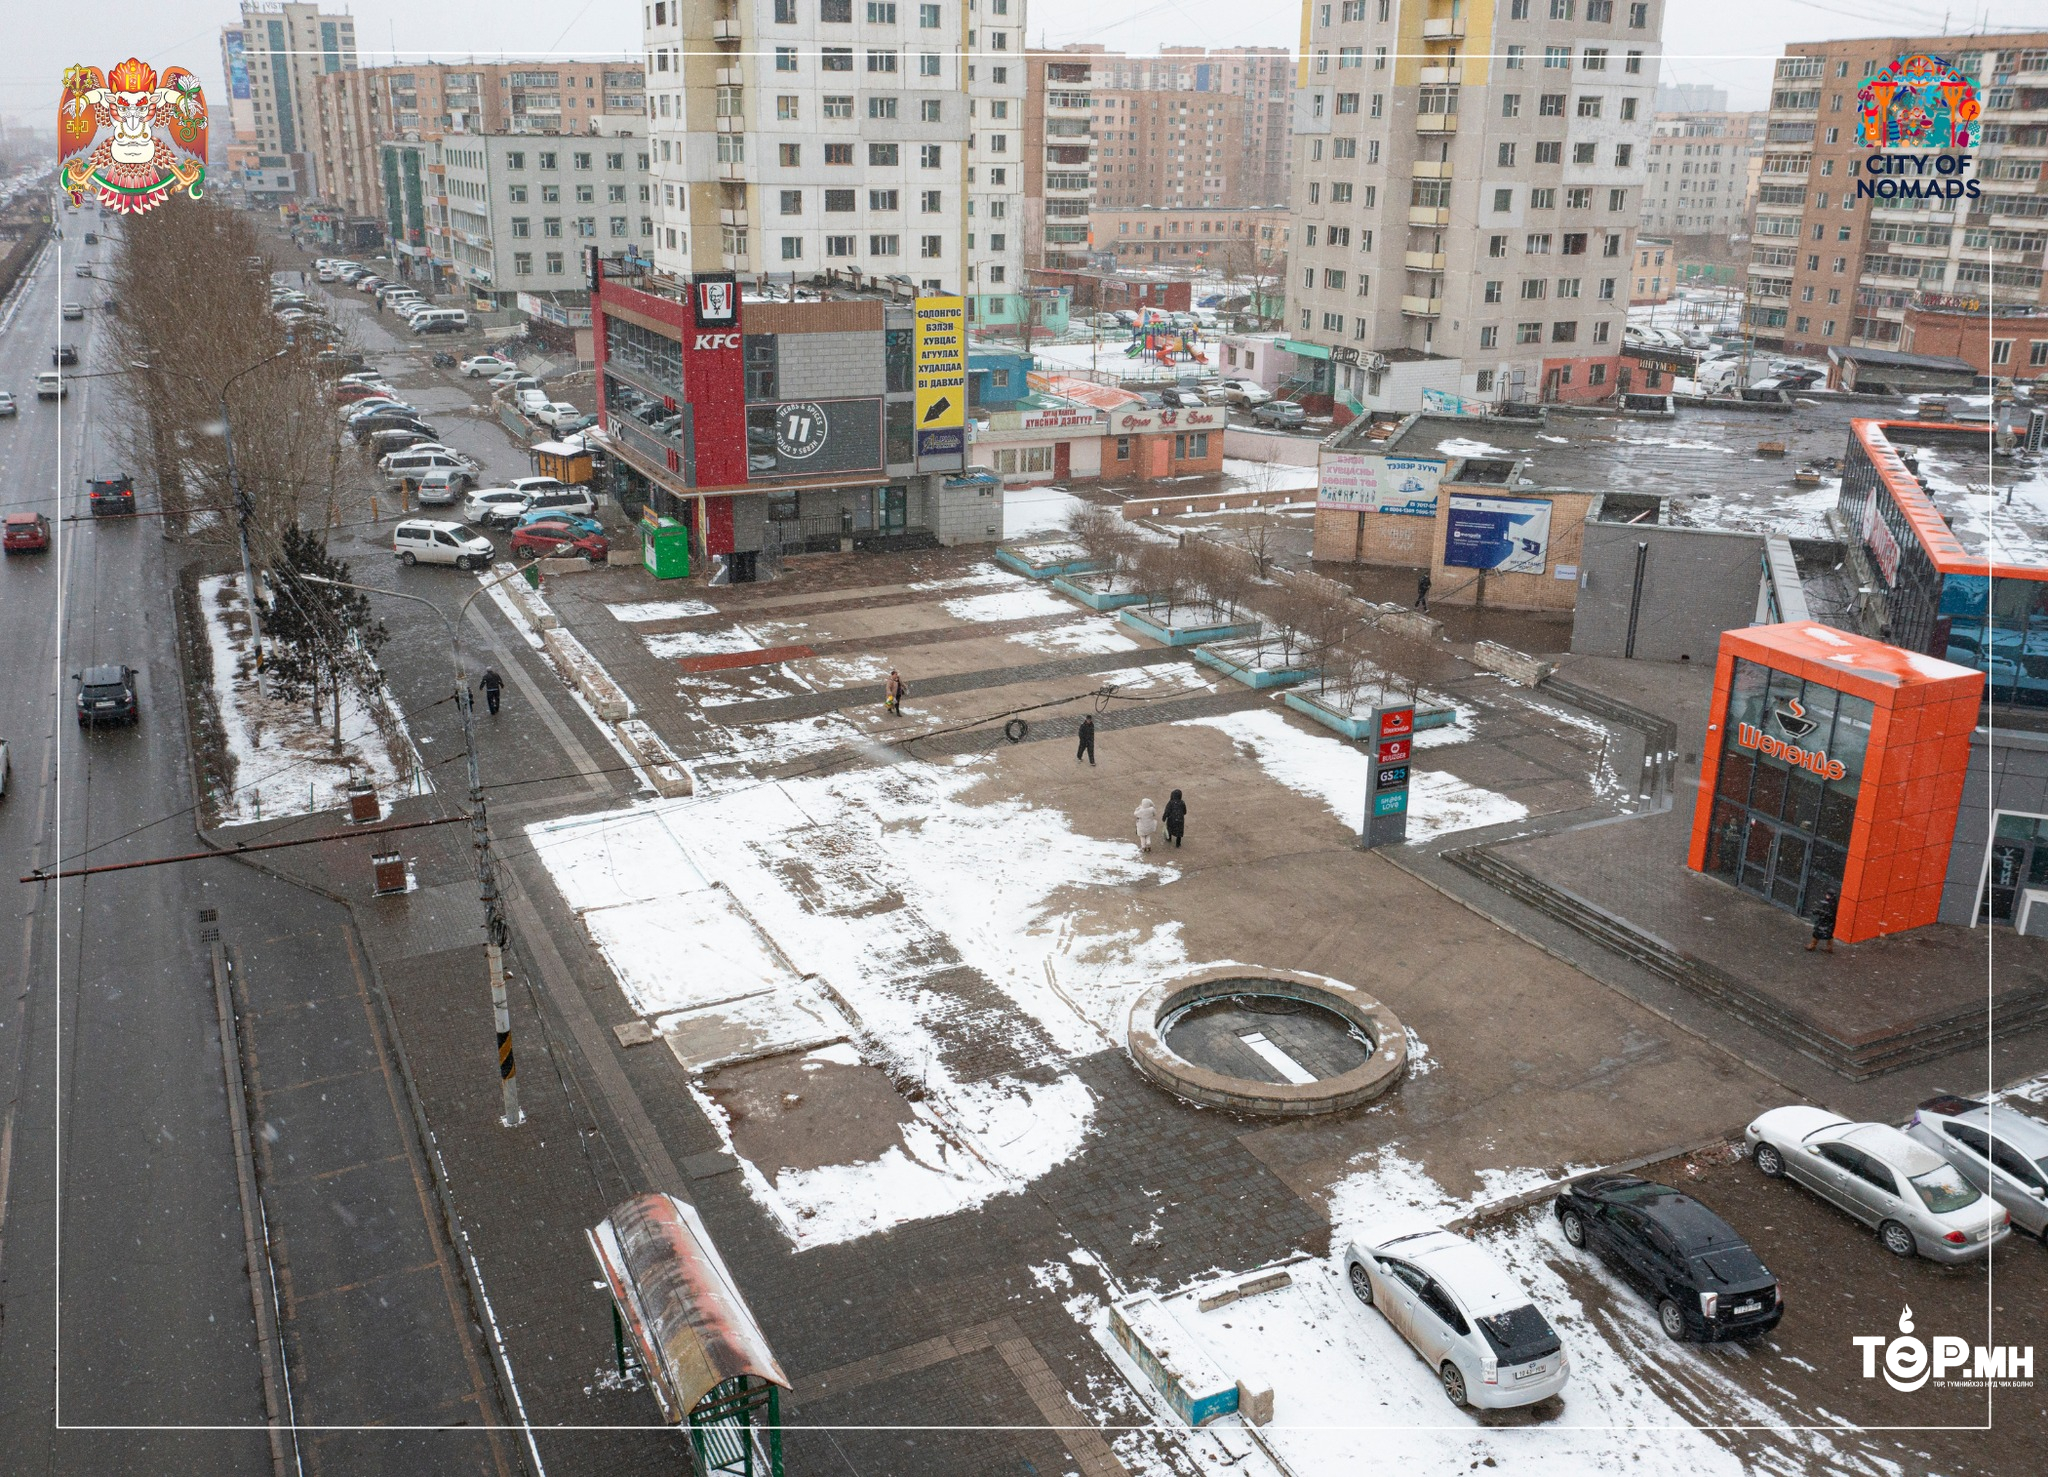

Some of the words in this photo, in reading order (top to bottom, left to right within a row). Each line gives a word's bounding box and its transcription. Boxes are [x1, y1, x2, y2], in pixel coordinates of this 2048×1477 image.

[918, 308, 962, 319] СОЛОНГОС
[926, 322, 954, 332] БЭЛЭН
[693, 333, 741, 350] KFC
[923, 336, 957, 346] ХУВЦАС
[921, 349, 959, 360] АГУУЛАХ
[918, 362, 962, 373] ХУДАЛДАА
[930, 377, 964, 389] ДАВХАР
[780, 404, 800, 418] HERBS
[806, 404, 824, 426] SPICES
[607, 417, 623, 441] KFC
[787, 415, 811, 443] 11
[799, 439, 819, 455] HERBS
[1387, 462, 1416, 471] ТЭЭВЭР
[1417, 463, 1438, 474] ЗУУЧ
[1380, 768, 1406, 782] GS25
